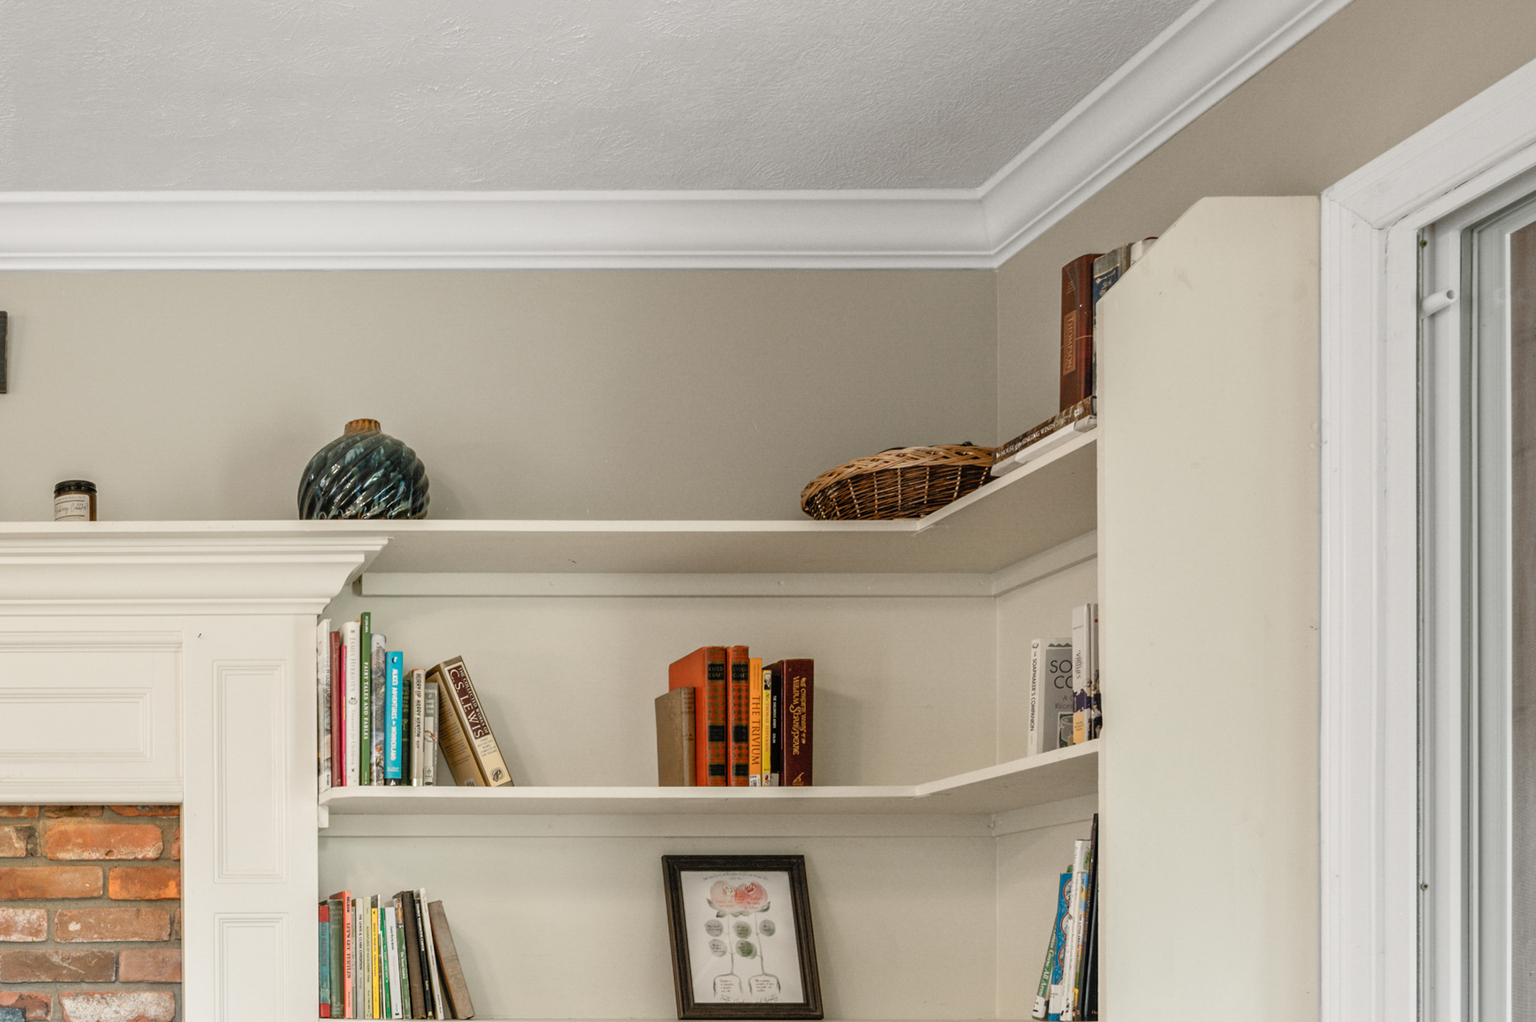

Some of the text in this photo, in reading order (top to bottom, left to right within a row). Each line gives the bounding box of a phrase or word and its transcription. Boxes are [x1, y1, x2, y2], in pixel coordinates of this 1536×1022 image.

[460, 694, 484, 738] LEWIS
[462, 678, 478, 707] COLLECTED
[475, 708, 485, 726] WORKS
[751, 695, 761, 765] THE TRIVIUM
